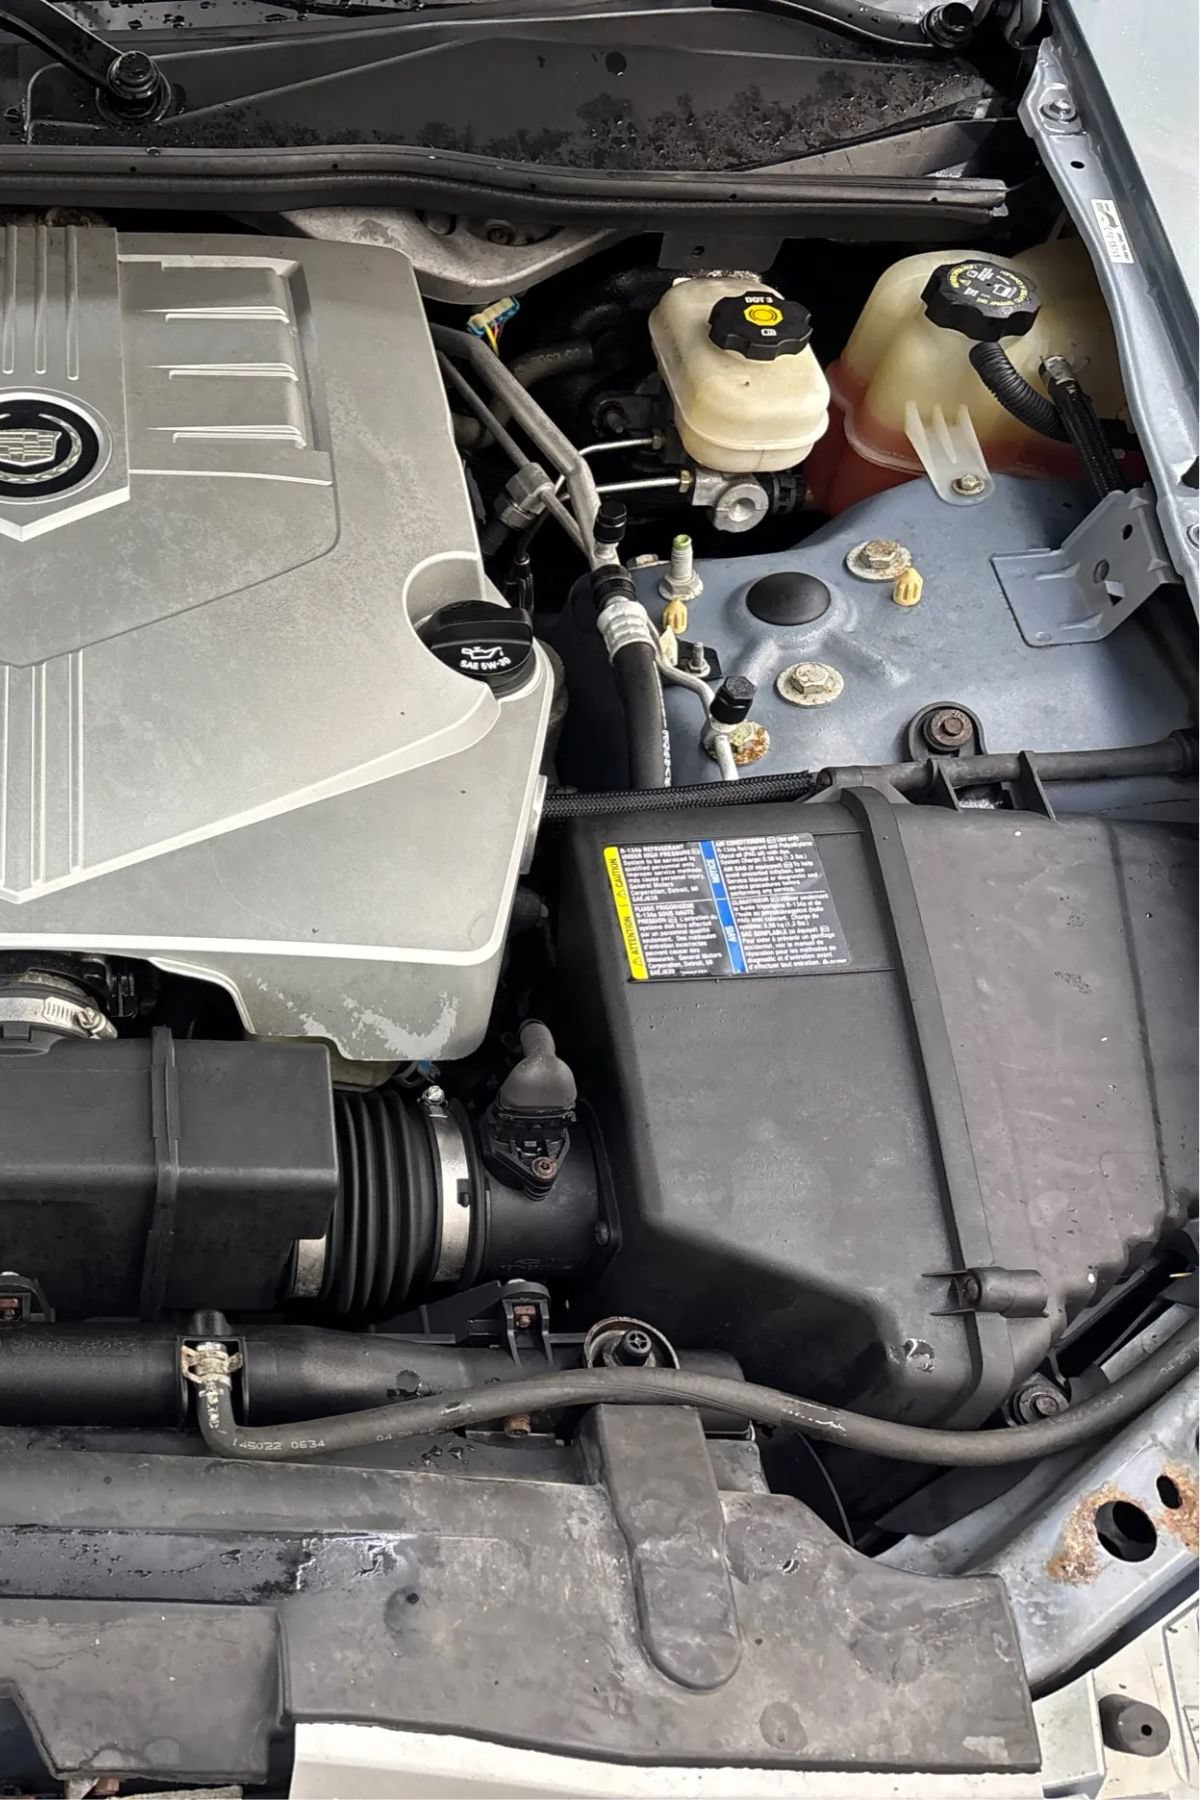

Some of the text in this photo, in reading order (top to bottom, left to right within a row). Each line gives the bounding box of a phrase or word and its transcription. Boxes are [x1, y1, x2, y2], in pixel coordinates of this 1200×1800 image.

[460, 657, 511, 670] SAE 5W-30
[609, 858, 623, 888] CAUTION
[706, 859, 720, 883] NOTICE
[624, 916, 639, 955] ATTENTION
[724, 925, 737, 942] AVIS
[291, 1439, 326, 1449] 0634
